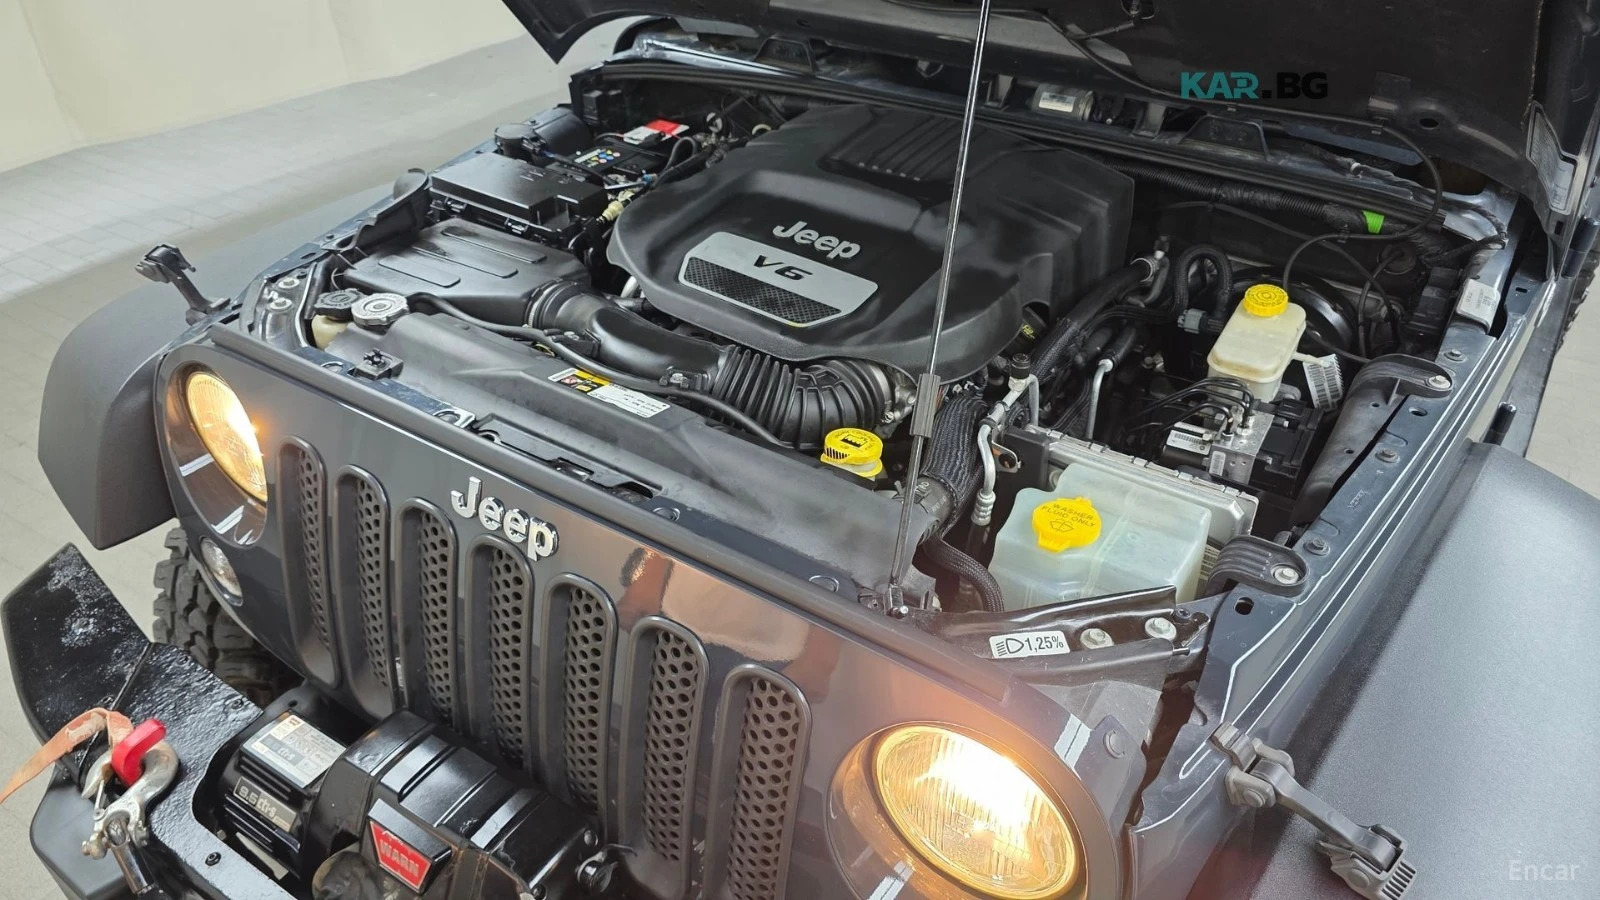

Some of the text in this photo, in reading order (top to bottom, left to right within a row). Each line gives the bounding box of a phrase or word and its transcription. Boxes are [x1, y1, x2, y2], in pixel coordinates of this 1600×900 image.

[772, 221, 862, 260] Jeep
[753, 254, 814, 281] V6
[450, 476, 560, 561] Jeep
[1041, 505, 1097, 528] FLUID ONLY
[1053, 503, 1094, 521] WASHER
[1025, 635, 1065, 653] 1,25%
[380, 838, 420, 878] WARN
